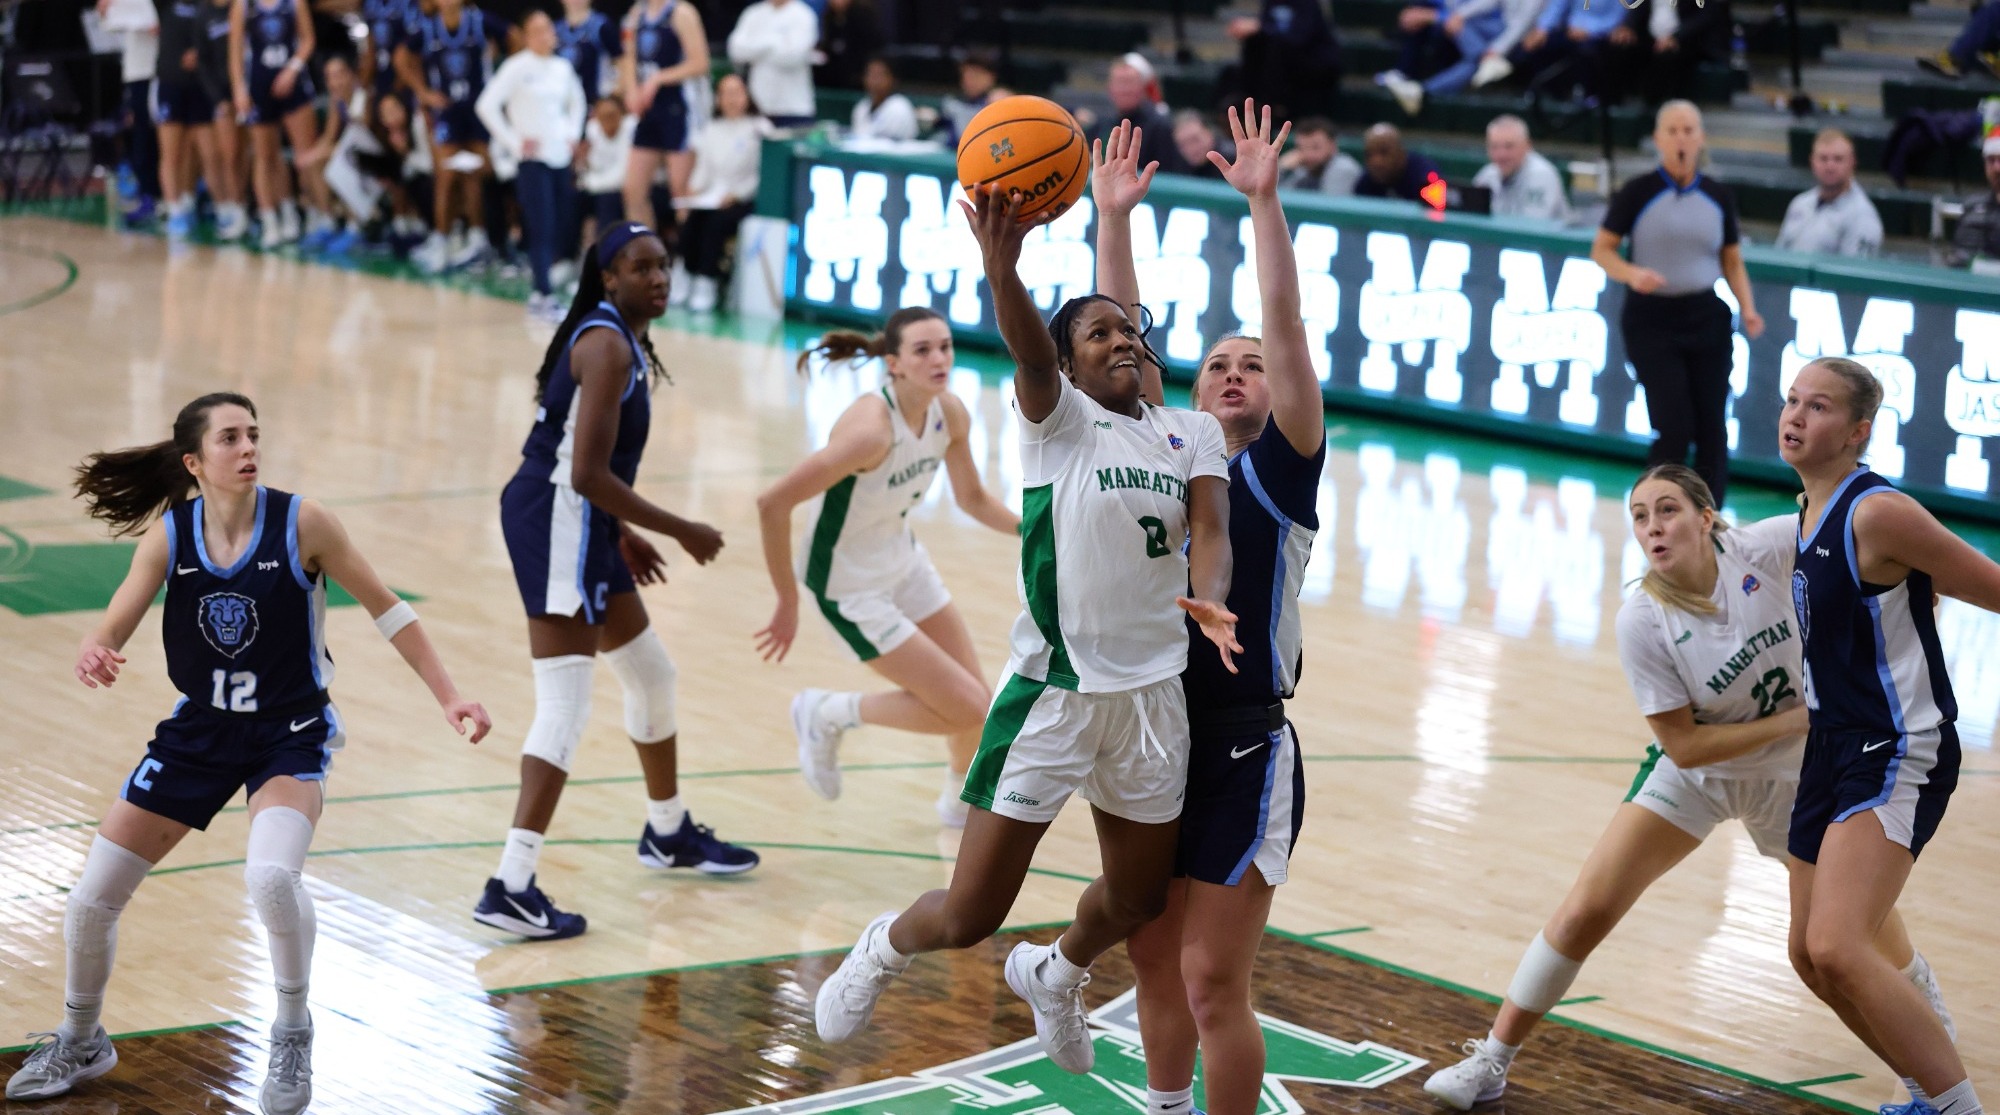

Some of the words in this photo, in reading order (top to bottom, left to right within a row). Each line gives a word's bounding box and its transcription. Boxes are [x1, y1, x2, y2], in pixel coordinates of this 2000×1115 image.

[211, 668, 258, 712] 12
[1751, 666, 1797, 717] 22
[134, 758, 164, 791] C
[1003, 791, 1041, 807] JASPERS
